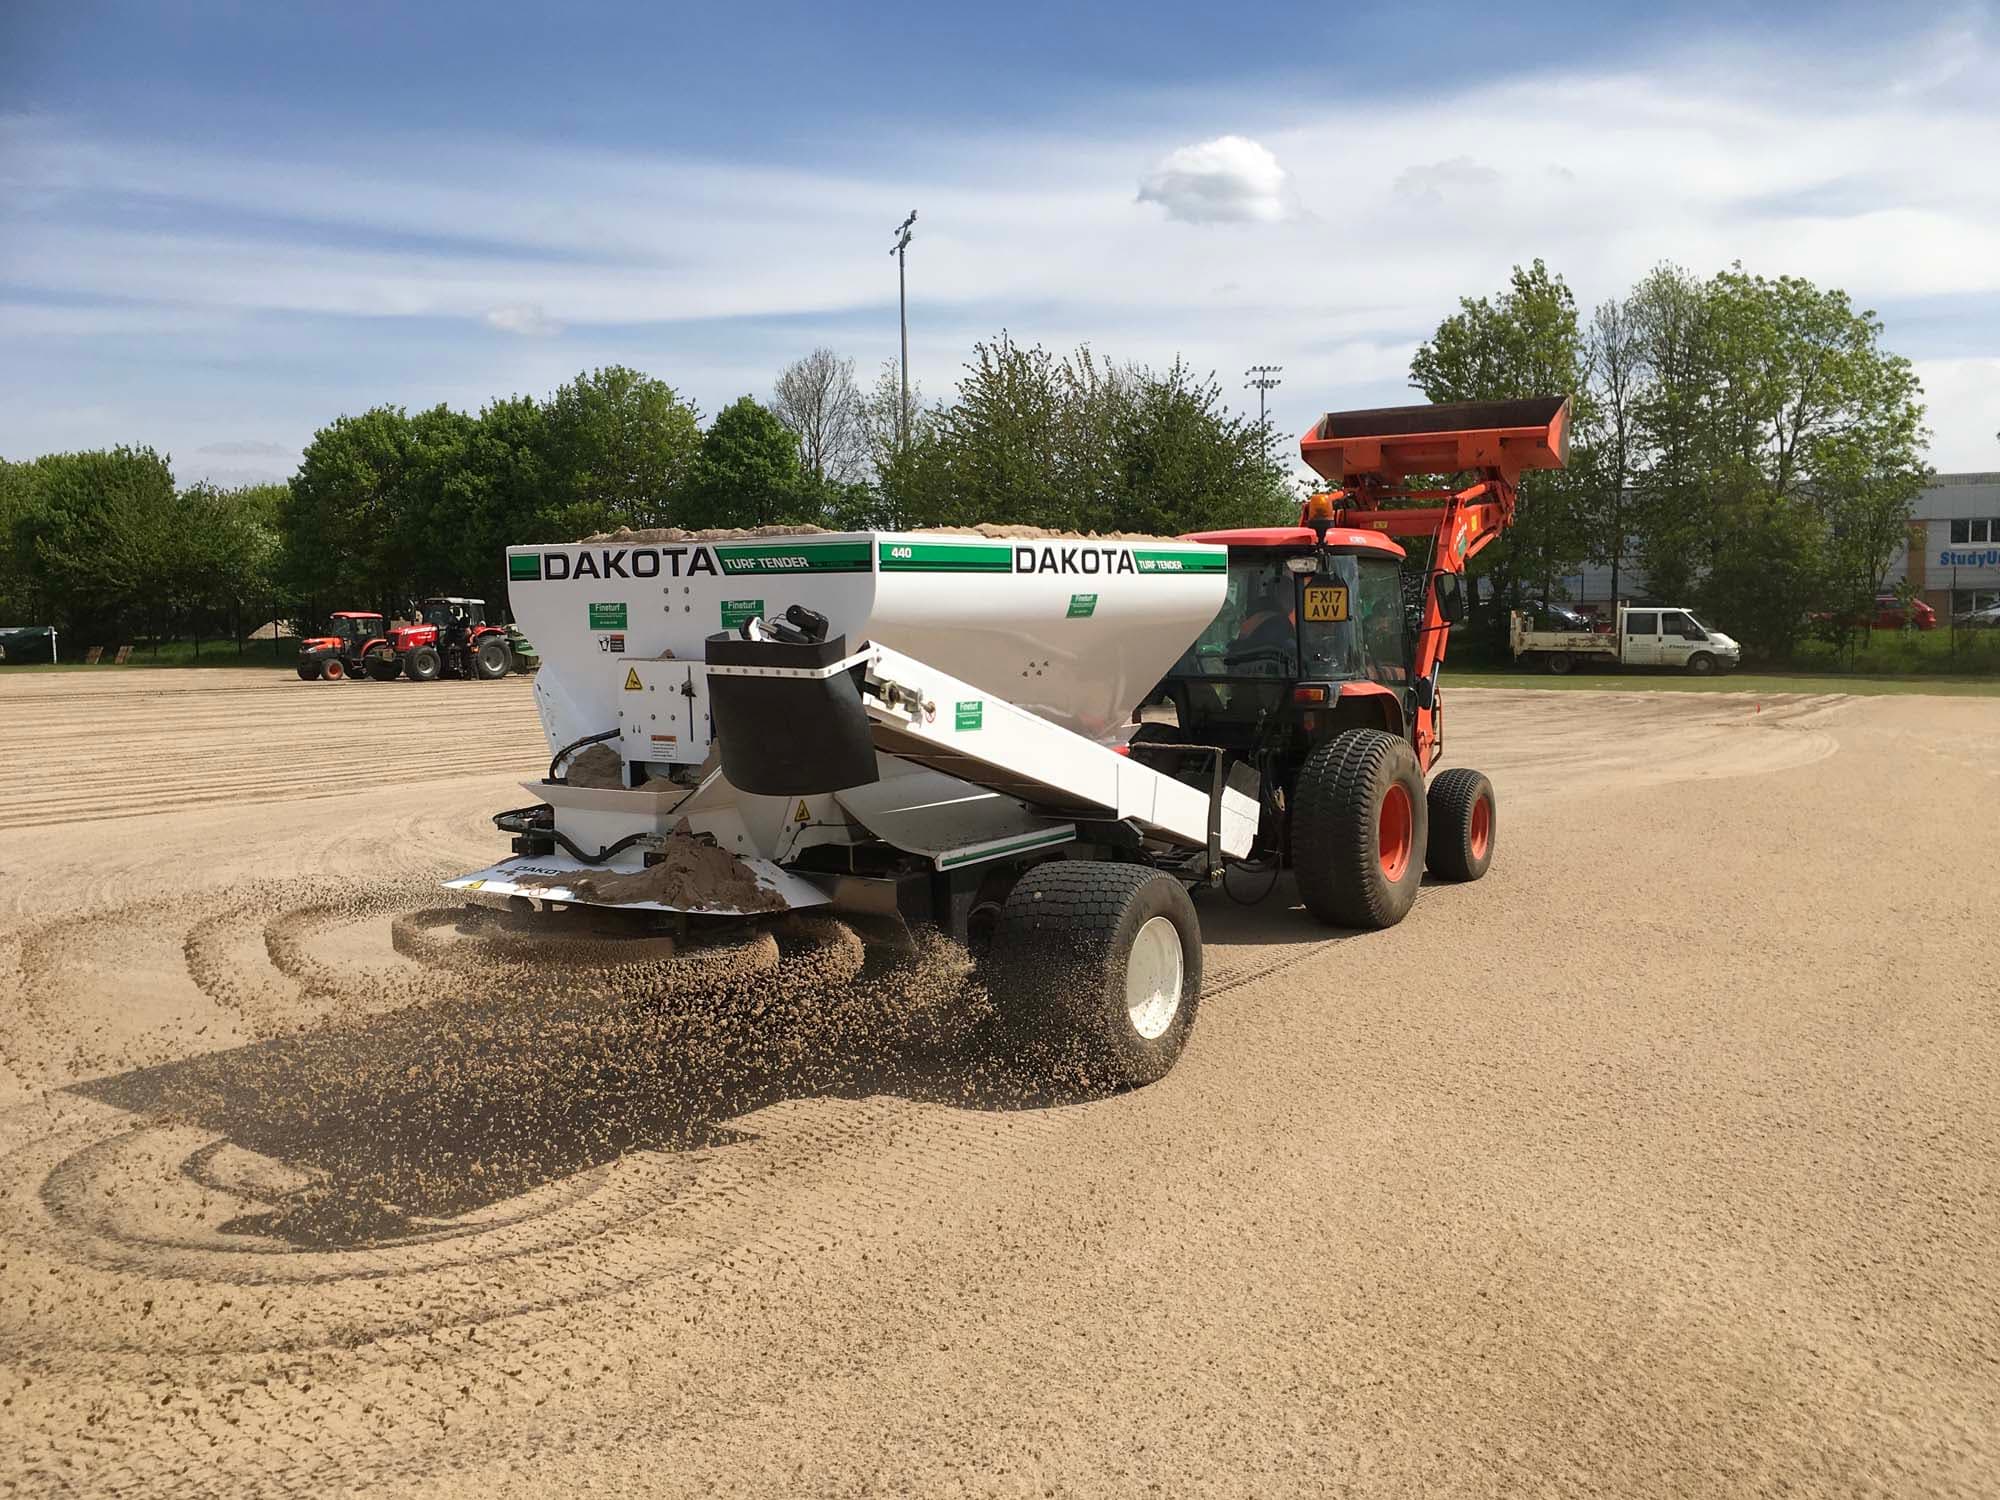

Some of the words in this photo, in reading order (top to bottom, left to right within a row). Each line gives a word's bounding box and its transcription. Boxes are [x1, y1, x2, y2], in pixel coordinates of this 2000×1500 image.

[891, 547, 912, 559] 440
[1940, 551, 2000, 568] StudyU
[544, 547, 718, 580] DAKOTA
[724, 558, 756, 569] TURF
[758, 556, 809, 568] TENDER
[1015, 547, 1135, 574] DAKOTA
[1137, 559, 1156, 569] TURF
[1156, 560, 1183, 570] TENDER
[1310, 590, 1342, 603] FX17
[728, 600, 756, 609] Fineturf
[1312, 604, 1340, 617] AVV
[514, 865, 561, 876] DAKO
